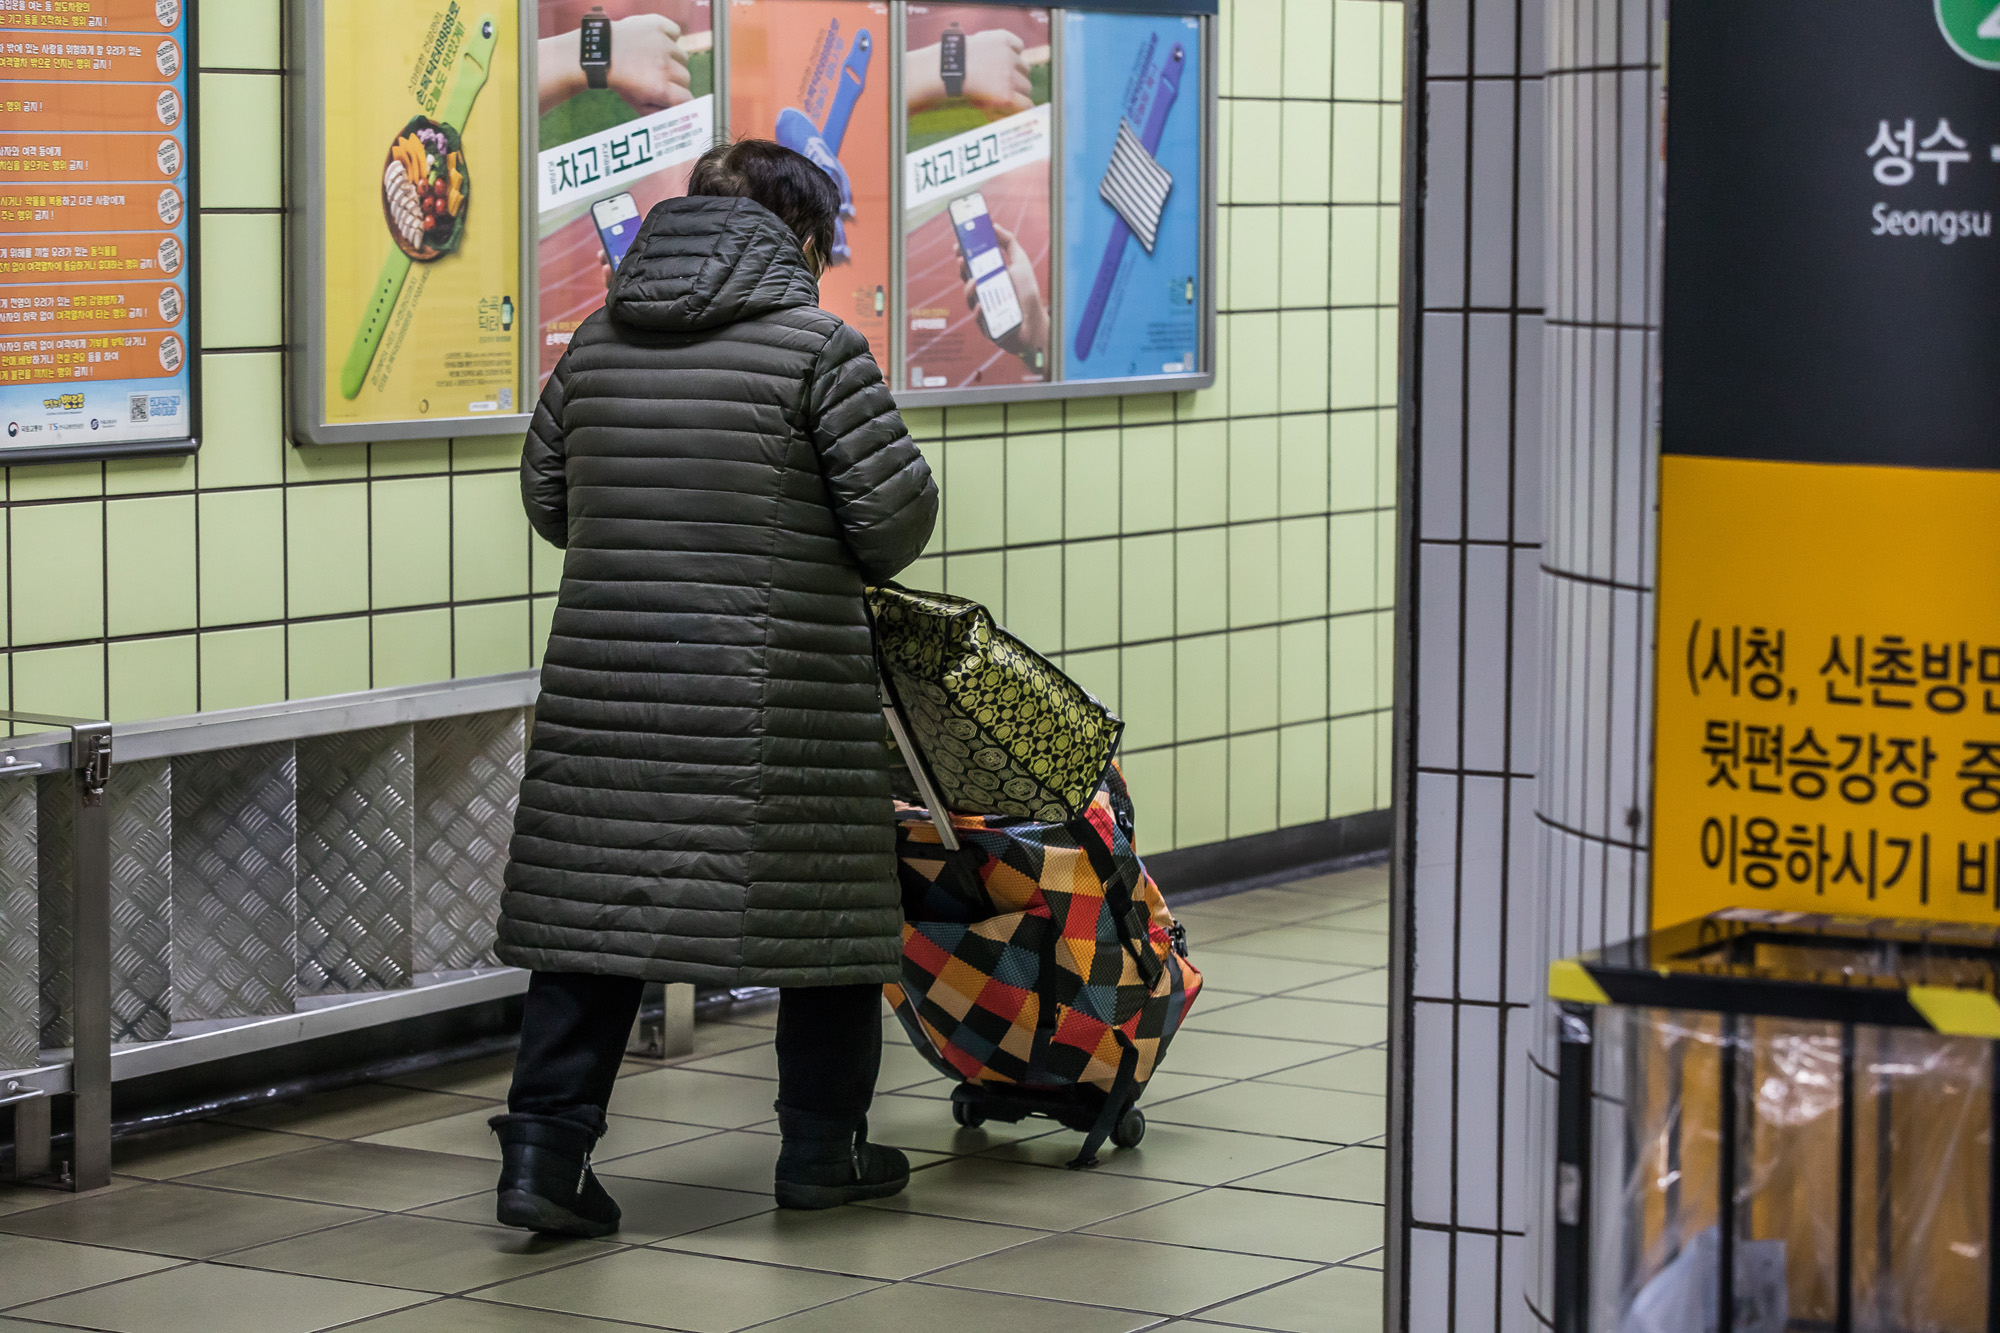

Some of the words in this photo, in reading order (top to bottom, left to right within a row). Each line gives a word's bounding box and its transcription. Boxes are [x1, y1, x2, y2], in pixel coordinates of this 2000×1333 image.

[28, 0, 42, 11] 여는
[45, 1, 52, 12] 등
[54, 1, 90, 13] 철도차량의
[8, 14, 22, 25] 기구
[24, 14, 38, 26] 등을
[40, 14, 69, 26] 조작하는
[71, 15, 87, 27] 행위
[6, 43, 23, 54] 밖에
[25, 43, 39, 55] 있는
[41, 43, 63, 55] 사람을
[65, 44, 95, 56] 위험하게
[96, 45, 104, 56] 할
[105, 45, 126, 57] 우려가
[128, 45, 142, 57] 있는
[0, 57, 28, 68] 여객열차
[30, 57, 51, 69] 밖으로
[76, 58, 91, 70] 행위
[6, 101, 21, 112] 행위
[21, 146, 37, 157] 여객
[39, 145, 61, 157] 등에게
[1865, 116, 1971, 186] 성수
[23, 159, 50, 171] 일으키는
[52, 160, 67, 171] 행위
[556, 146, 601, 191] 차고
[610, 128, 654, 174] 보고
[920, 150, 956, 190] 차고
[965, 133, 1000, 174] 보고
[0, 196, 22, 207] 시거나
[24, 195, 46, 207] 약물을
[48, 195, 77, 207] 복용하고
[78, 195, 93, 207] 다른
[95, 195, 125, 206] 사람에게
[1, 210, 15, 221] 주는
[17, 209, 33, 221] 행위
[1871, 201, 1992, 245] Seongsu
[9, 247, 32, 259] 위해를
[51, 246, 73, 258] 우려가
[74, 246, 89, 257] 있는
[90, 245, 118, 257] 동식물을
[12, 261, 26, 273] 없이
[27, 260, 63, 273] 여객열차에
[33, 296, 55, 308] 우려가
[56, 295, 70, 307] 있는
[23, 311, 38, 322] 허락
[39, 310, 55, 322] 없이
[56, 309, 94, 321] 여객열차에
[95, 308, 110, 320] 타는
[112, 308, 127, 320] 행위
[23, 340, 38, 352] 허락
[39, 339, 55, 351] 없이
[56, 338, 86, 350] 여객에게
[87, 351, 102, 363] 등을
[103, 350, 119, 362] 하여
[57, 366, 72, 379] 행위
[1685, 617, 1799, 706] (시청,
[1701, 717, 1938, 809] 뒷편승강장
[1699, 813, 1931, 907] 이용하시기
